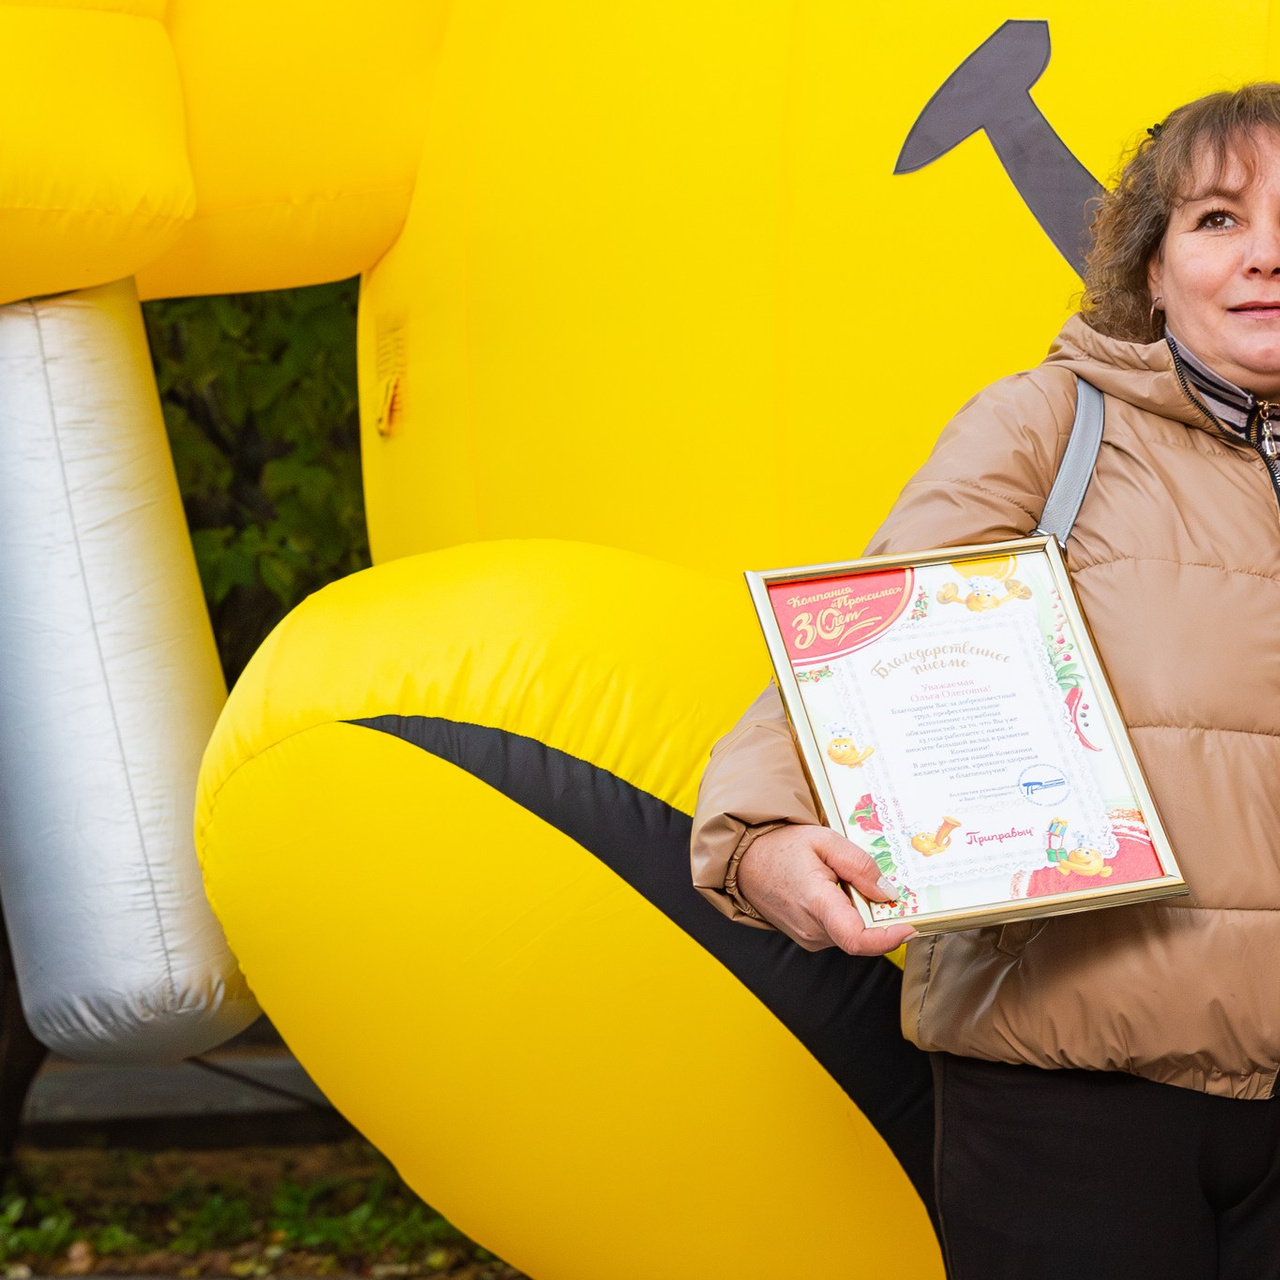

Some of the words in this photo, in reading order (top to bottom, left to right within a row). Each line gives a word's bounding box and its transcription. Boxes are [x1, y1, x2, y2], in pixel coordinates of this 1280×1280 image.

[786, 586, 853, 608] Компания
[830, 586, 902, 609] «Проксима»
[791, 607, 845, 649] 30
[870, 640, 1010, 679] Благодарственное
[910, 658, 969, 674] письмо
[920, 679, 975, 692] Уважаемая
[910, 693, 942, 702] Ольга
[965, 826, 1033, 846] Приправыч
